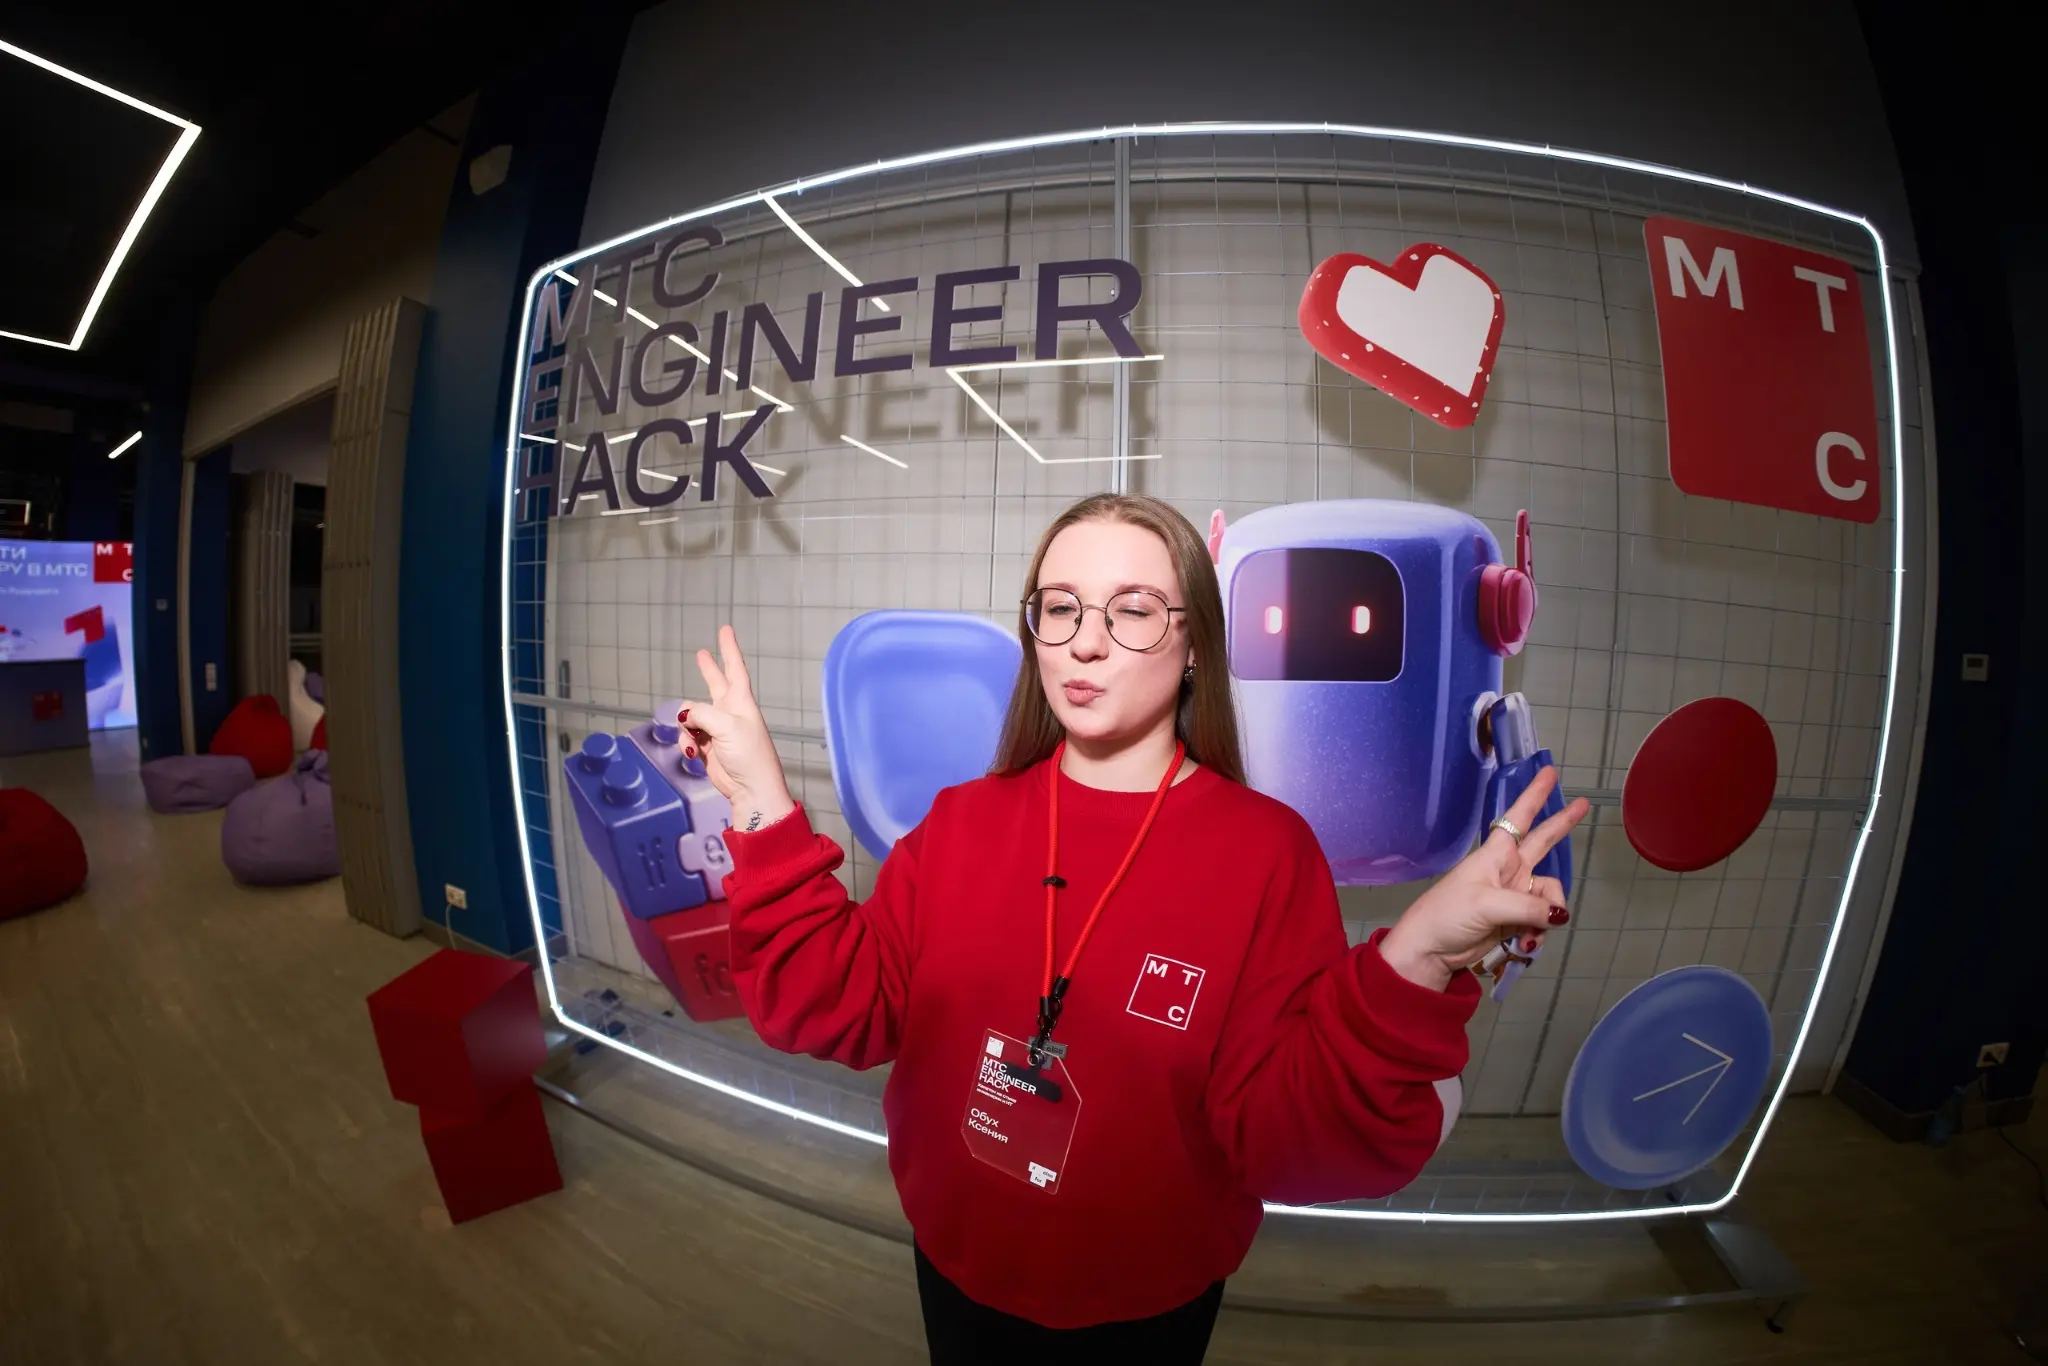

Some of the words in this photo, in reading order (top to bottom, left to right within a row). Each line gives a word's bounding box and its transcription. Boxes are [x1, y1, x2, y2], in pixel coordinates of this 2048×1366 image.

[522, 257, 1145, 436] ENGINEER
[515, 402, 778, 522] HACK
[0, 546, 27, 560] ТИ
[0, 562, 23, 575] РУ
[27, 563, 41, 577] В
[45, 563, 88, 577] МТС
[979, 1072, 1011, 1093] HACK
[981, 1064, 1037, 1095] ENGINEER
[970, 1107, 999, 1128] Обух
[967, 1117, 1009, 1144] Ксения
